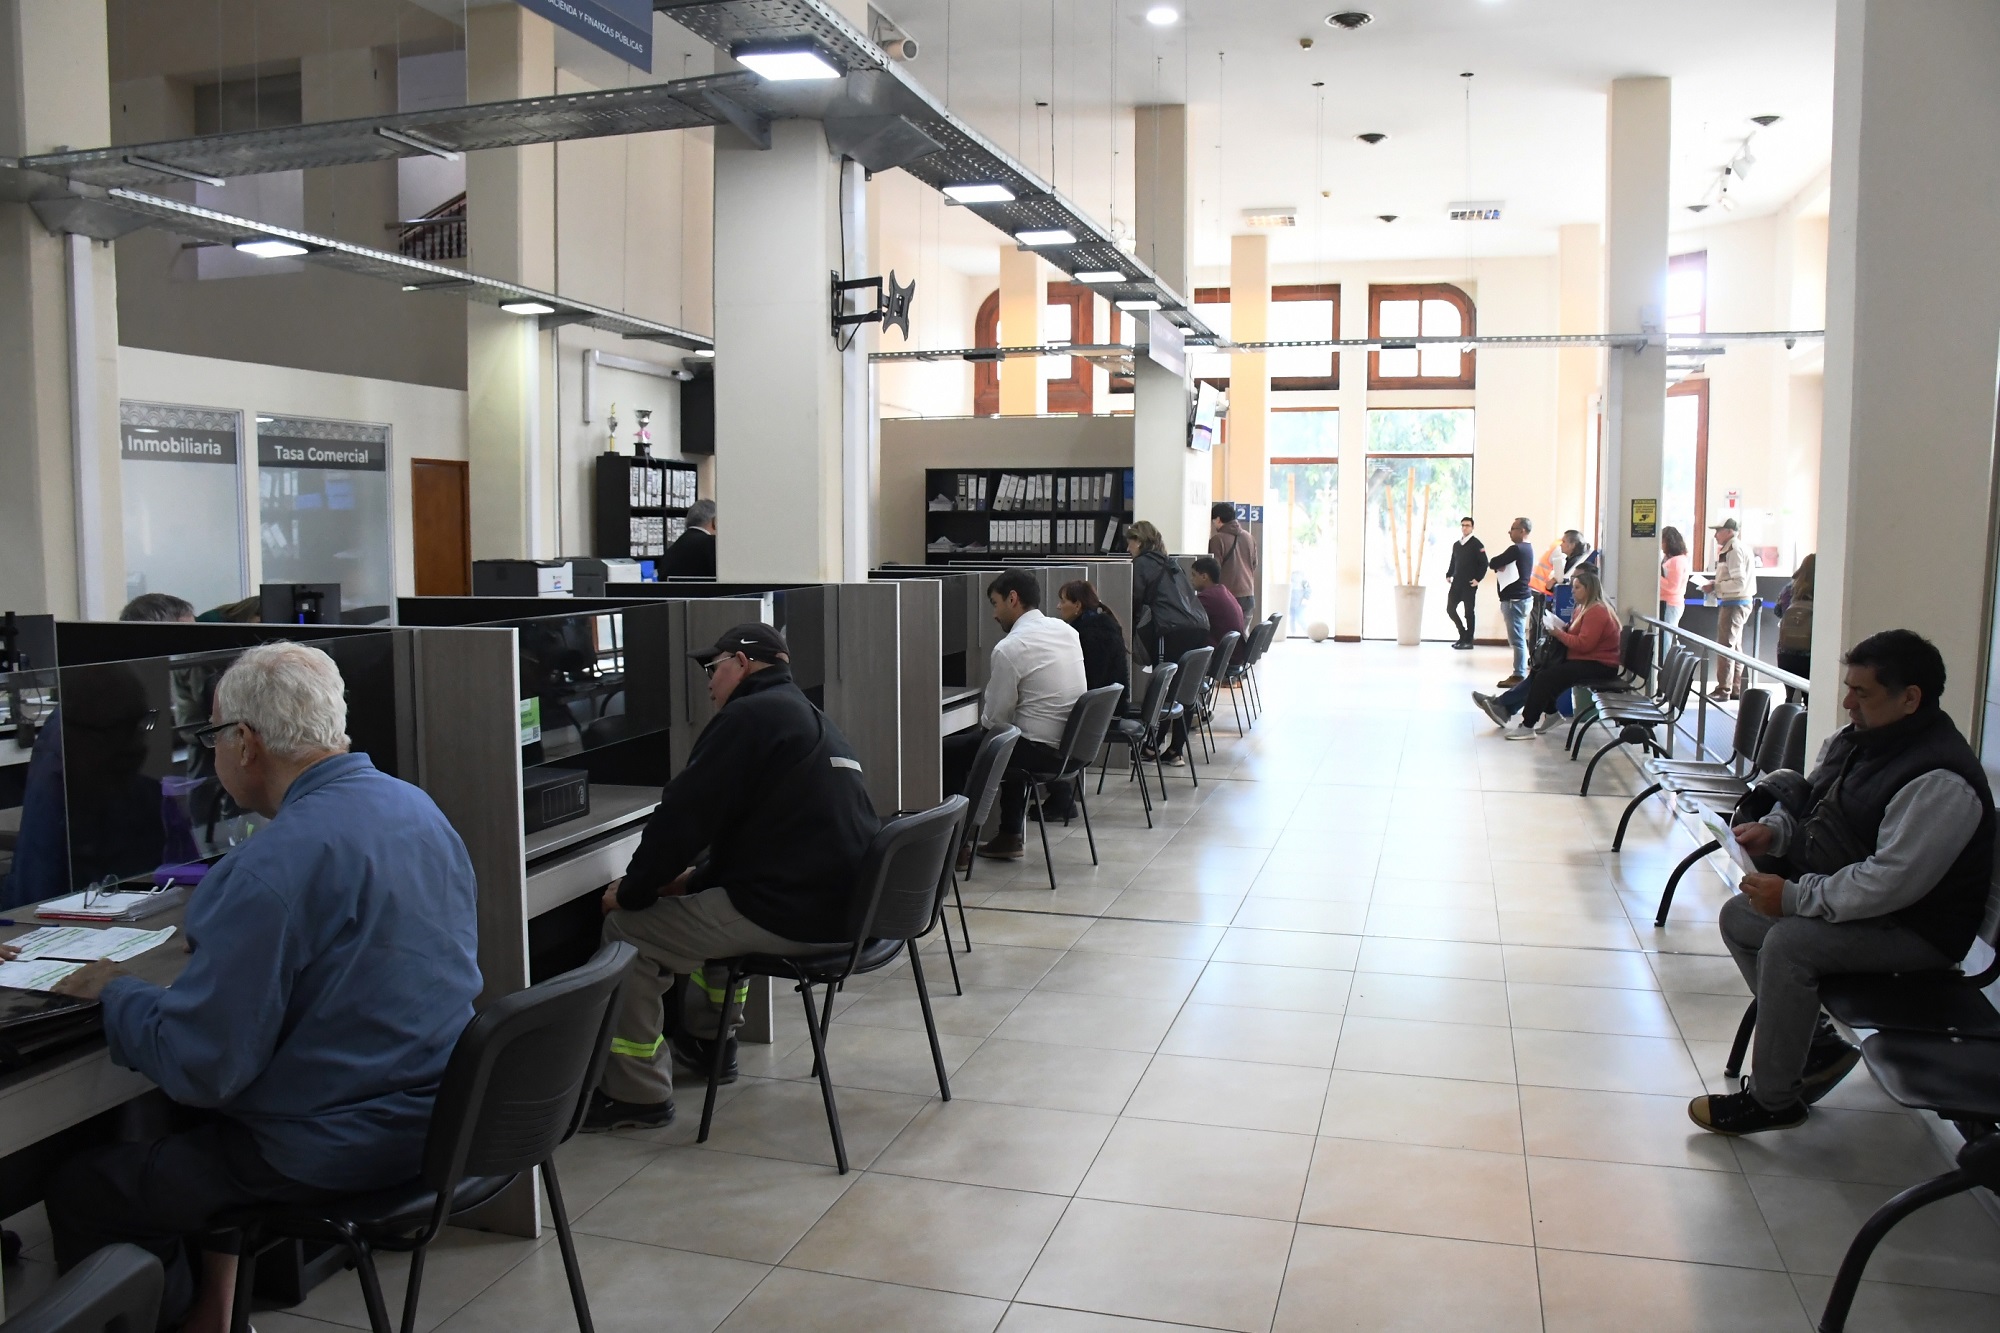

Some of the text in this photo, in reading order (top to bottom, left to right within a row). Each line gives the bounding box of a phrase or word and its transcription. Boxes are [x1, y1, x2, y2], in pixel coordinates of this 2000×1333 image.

[578, 10, 584, 20] Y
[584, 13, 614, 38] FINANZAS
[615, 30, 643, 53] PÚBLICAS
[127, 435, 222, 455] Inmobiliaria
[274, 445, 369, 463] Tasa Comercial
[1237, 508, 1246, 520] 2
[1251, 510, 1260, 521] 3
